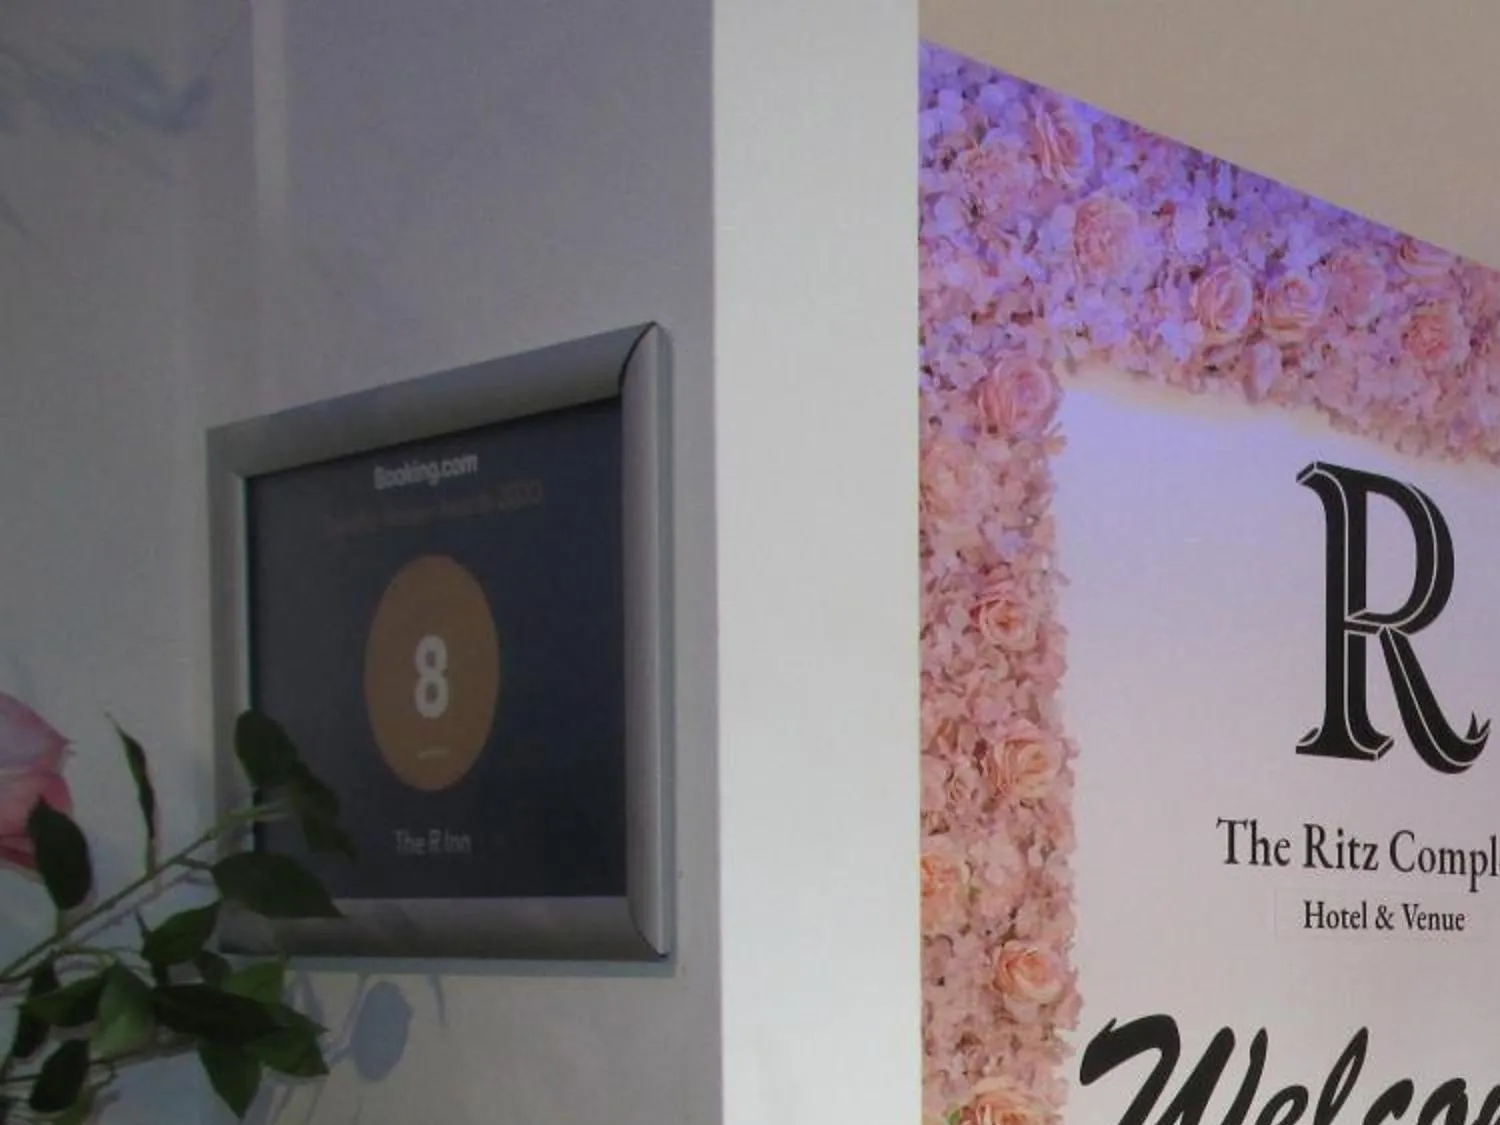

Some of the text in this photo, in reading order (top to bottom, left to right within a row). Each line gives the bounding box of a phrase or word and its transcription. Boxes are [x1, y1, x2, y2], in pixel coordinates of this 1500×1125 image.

[373, 452, 479, 490] Booking.com
[1296, 461, 1490, 774] R
[415, 634, 449, 719] 8
[392, 828, 472, 855] The R Inn
[1216, 816, 1291, 868] The
[1303, 823, 1380, 874] Ritz
[1303, 900, 1466, 933] Hotel & Venue
